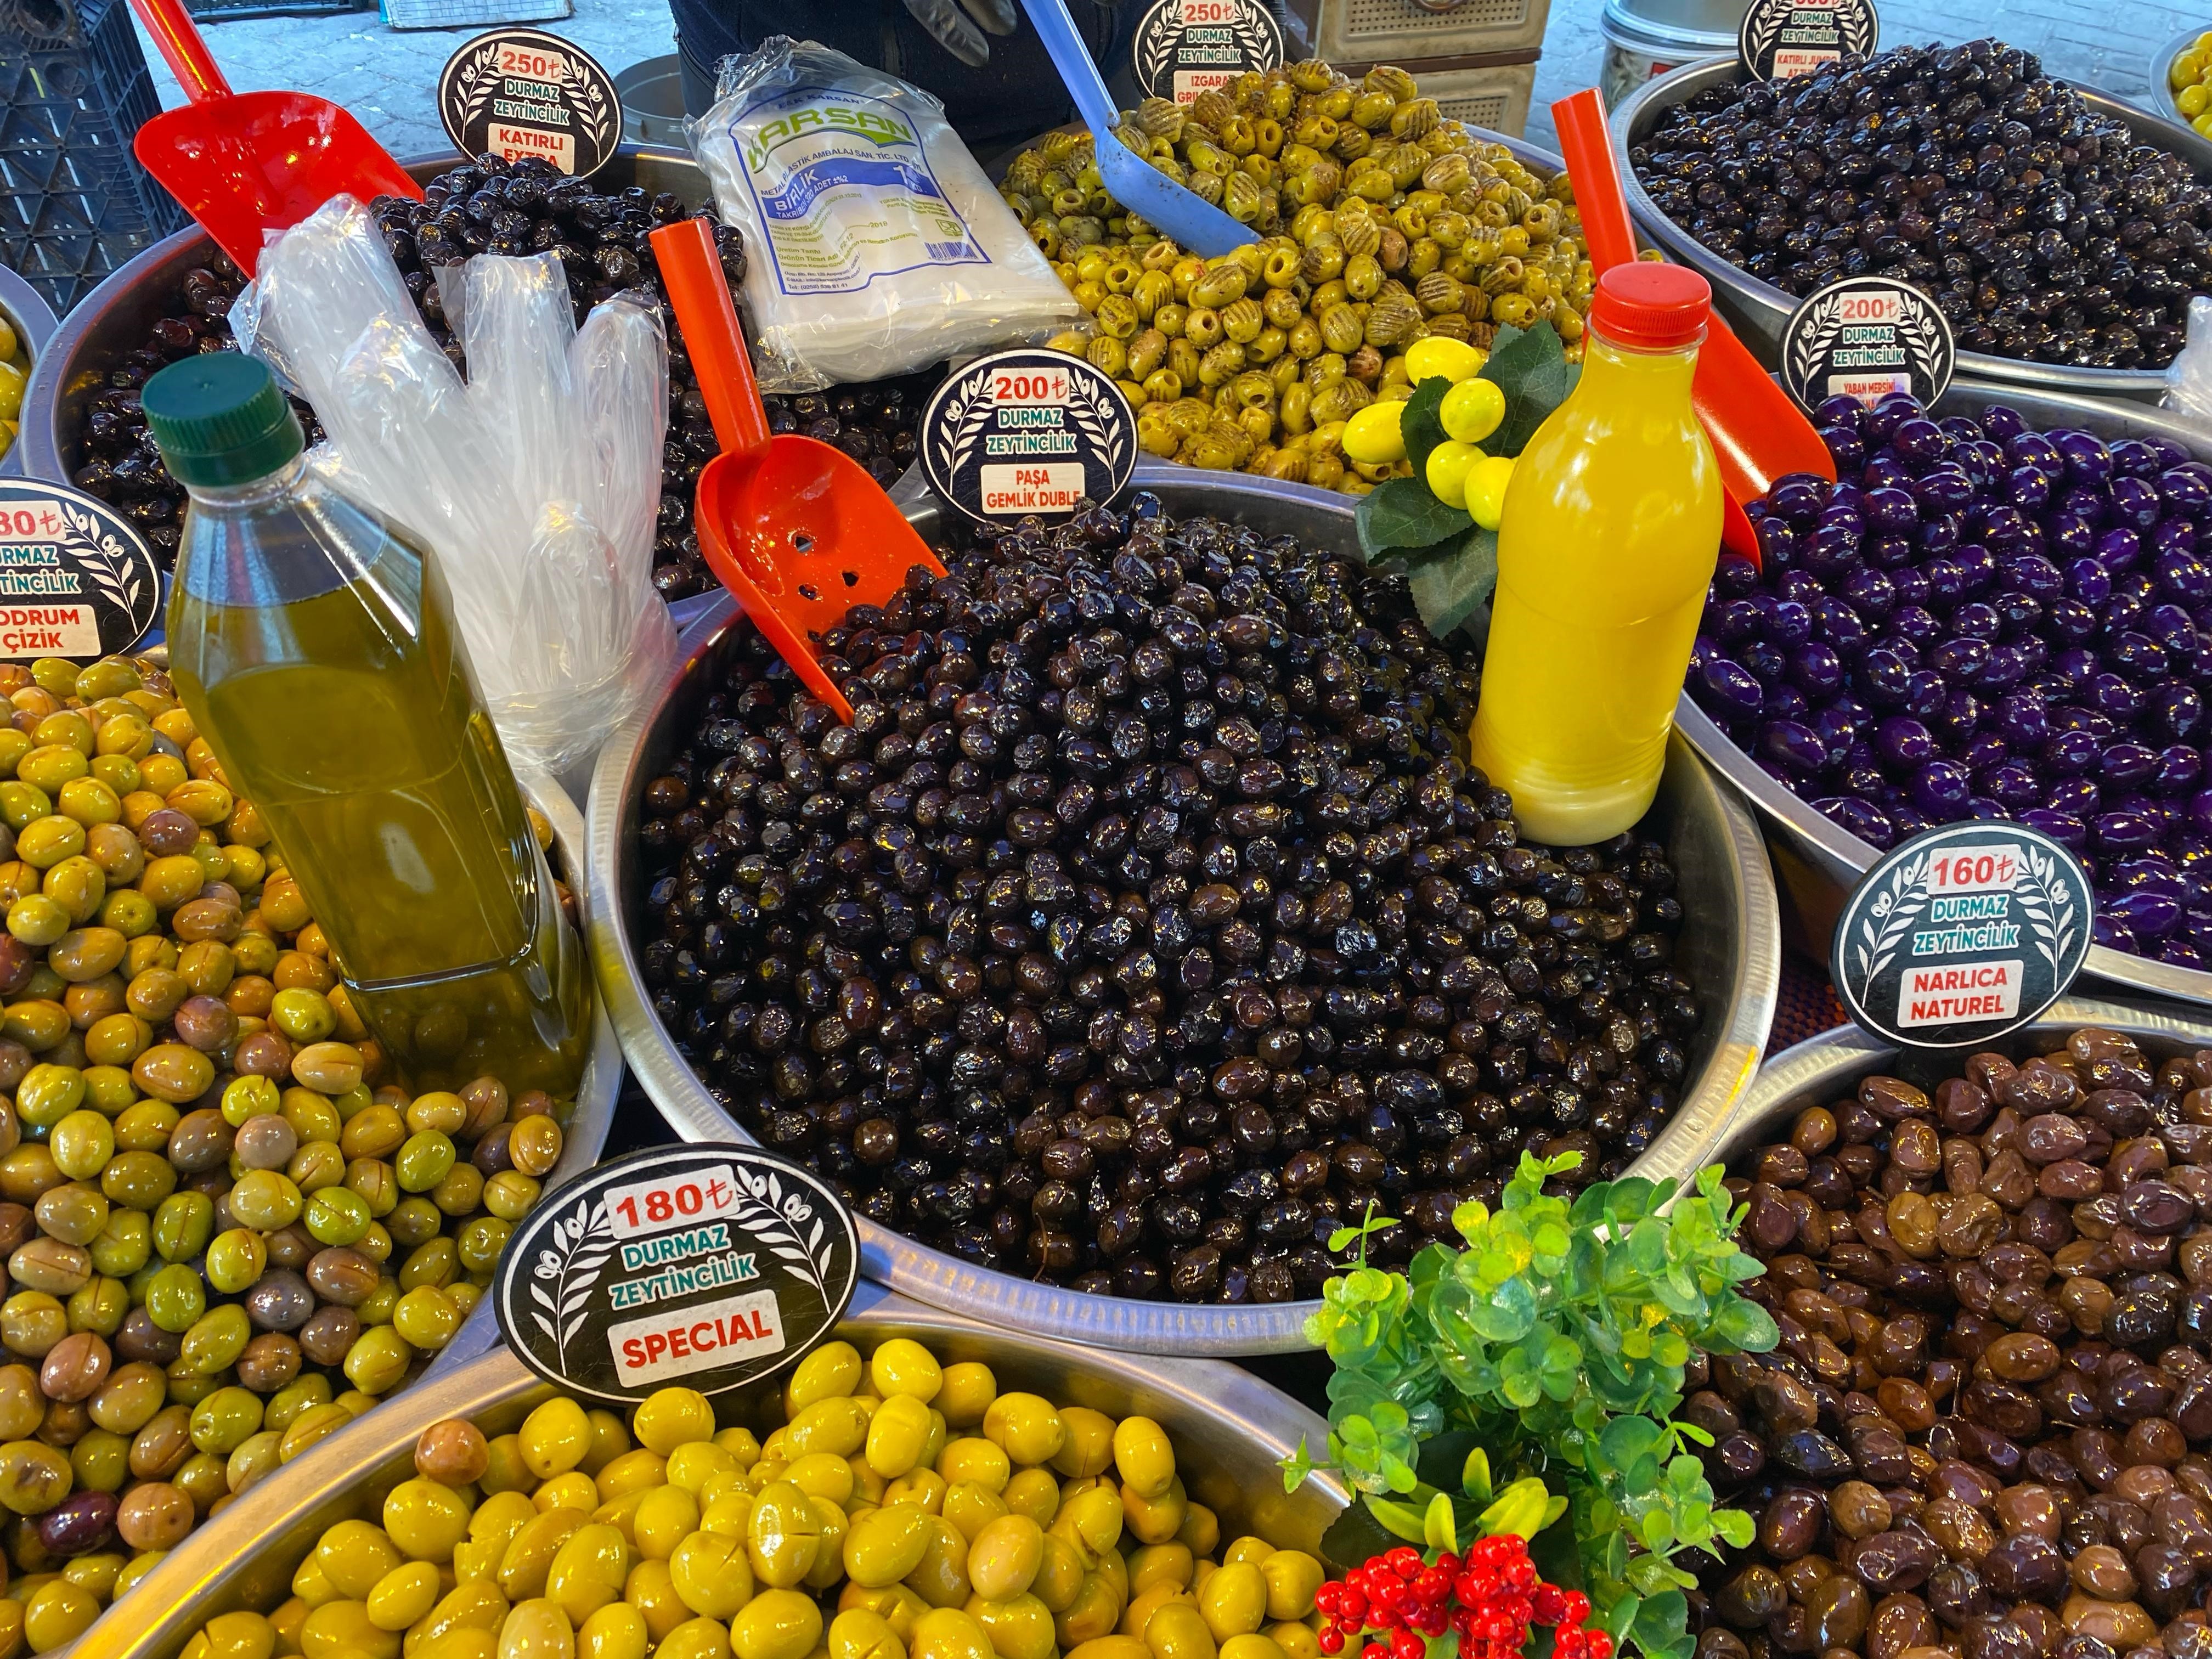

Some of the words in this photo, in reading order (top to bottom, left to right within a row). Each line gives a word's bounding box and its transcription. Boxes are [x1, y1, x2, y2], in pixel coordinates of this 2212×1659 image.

[1793, 12, 1832, 24] DURMAZ
[1188, 30, 1231, 42] DURMAZ
[1783, 29, 1839, 42] ZEYTİNCİLİK
[1180, 46, 1241, 62] ZEYTİNCİLİK
[1778, 55, 1807, 64] KATIRLI
[506, 81, 558, 100] DURMAZ
[495, 100, 569, 124] ZEYTİNCİLİK
[500, 129, 563, 150] KATIRLI
[761, 180, 786, 195] METAL
[782, 155, 811, 182] PLASTİK
[812, 148, 854, 160] AMBALAJ
[775, 169, 819, 210] BİRLİK
[814, 178, 831, 193] ADET
[1844, 328, 1894, 342] DURMAZ
[1833, 347, 1904, 365] ZEYTİNCİLİK
[1844, 383, 1866, 394] YABAN
[1000, 410, 1062, 426] DURMAZ
[988, 430, 1075, 452] ZEYTİNCİLİK
[1016, 470, 1050, 489] PAŞA
[987, 488, 1036, 508] GEMLİK
[3, 628, 64, 653] ÇİZİK
[1934, 897, 2008, 920] DURMAZ
[1914, 922, 2018, 953] ZEYTİNCİLİK
[1914, 967, 2007, 993] NARLICA
[1910, 995, 2005, 1020] NATUREL
[624, 1227, 729, 1269] DURMAZ
[612, 1254, 757, 1308] ZEYTİNCİLİK
[623, 1310, 773, 1368] SPECIAL
